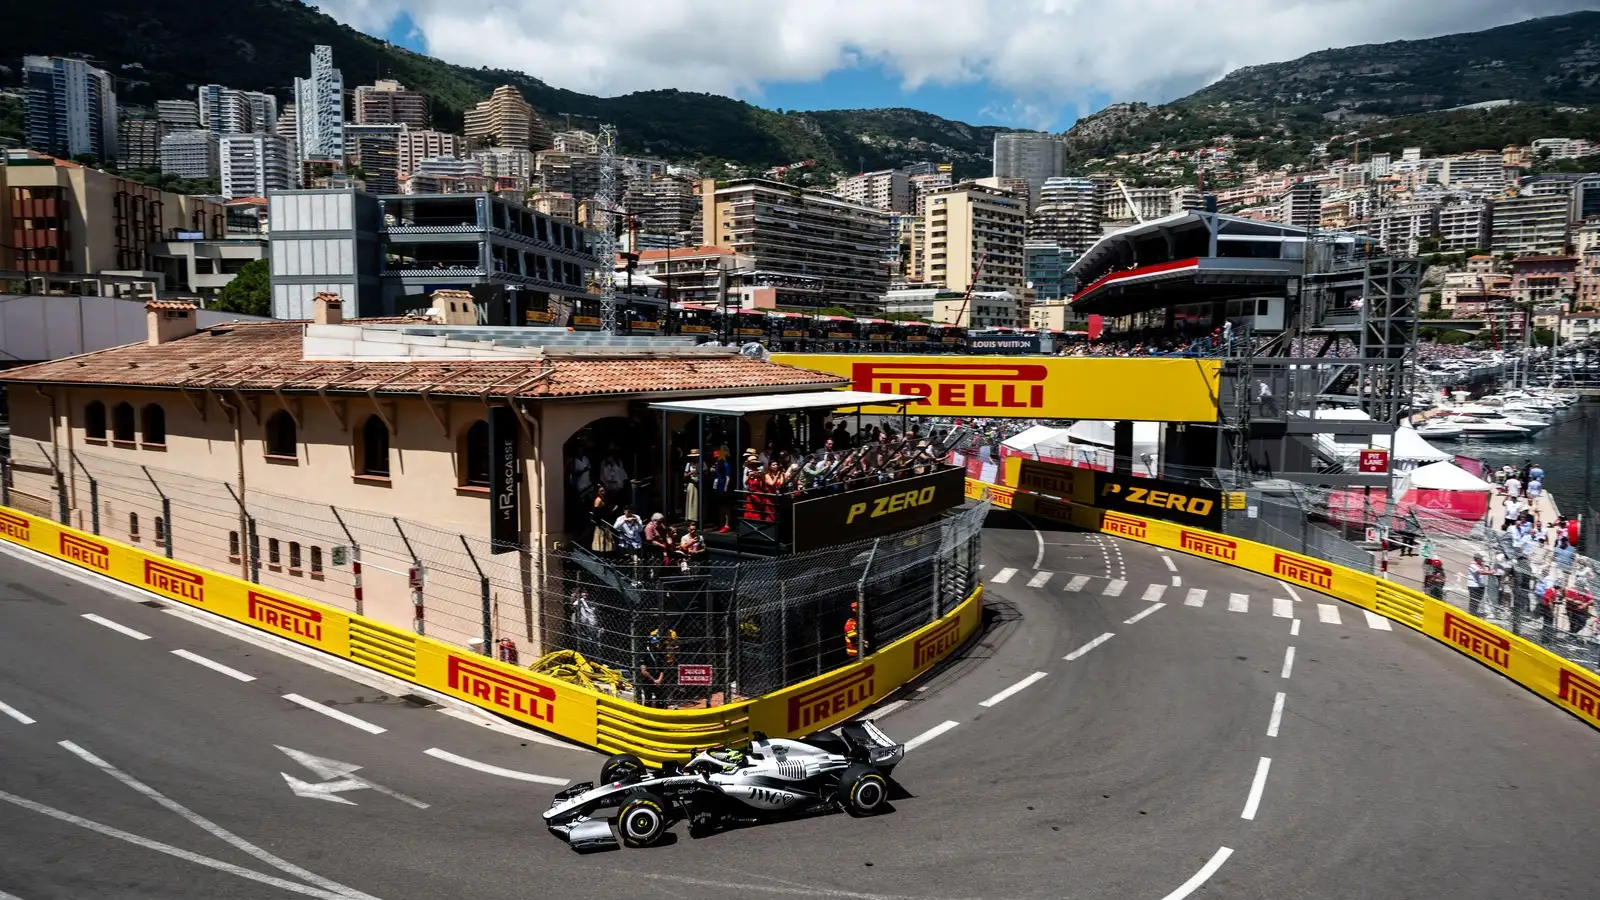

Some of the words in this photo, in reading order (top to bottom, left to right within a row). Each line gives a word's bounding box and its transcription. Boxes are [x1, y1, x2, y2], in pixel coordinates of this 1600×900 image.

[973, 340, 996, 348] LOUIS
[996, 340, 1031, 348] VUITTON
[852, 363, 1048, 408] PIRELLI
[499, 439, 514, 510] RASCASSE
[1020, 464, 1075, 494] PIRELLI
[846, 502, 867, 525] P
[870, 485, 936, 518] ZERO
[1101, 483, 1121, 496] P
[1125, 487, 1214, 516] ZERO
[1101, 512, 1146, 538] PIRELLI
[1180, 530, 1237, 560] PIRELLI
[60, 531, 109, 571] PIRELLI
[1274, 553, 1332, 590] PIRELLI
[144, 558, 204, 602] PIRELLI
[248, 590, 322, 642] PIRELLI
[913, 615, 961, 670] PIRELLI
[1443, 611, 1510, 669] PIRELLI
[448, 654, 556, 724] PIRELLI
[787, 664, 875, 734] PIRELLI
